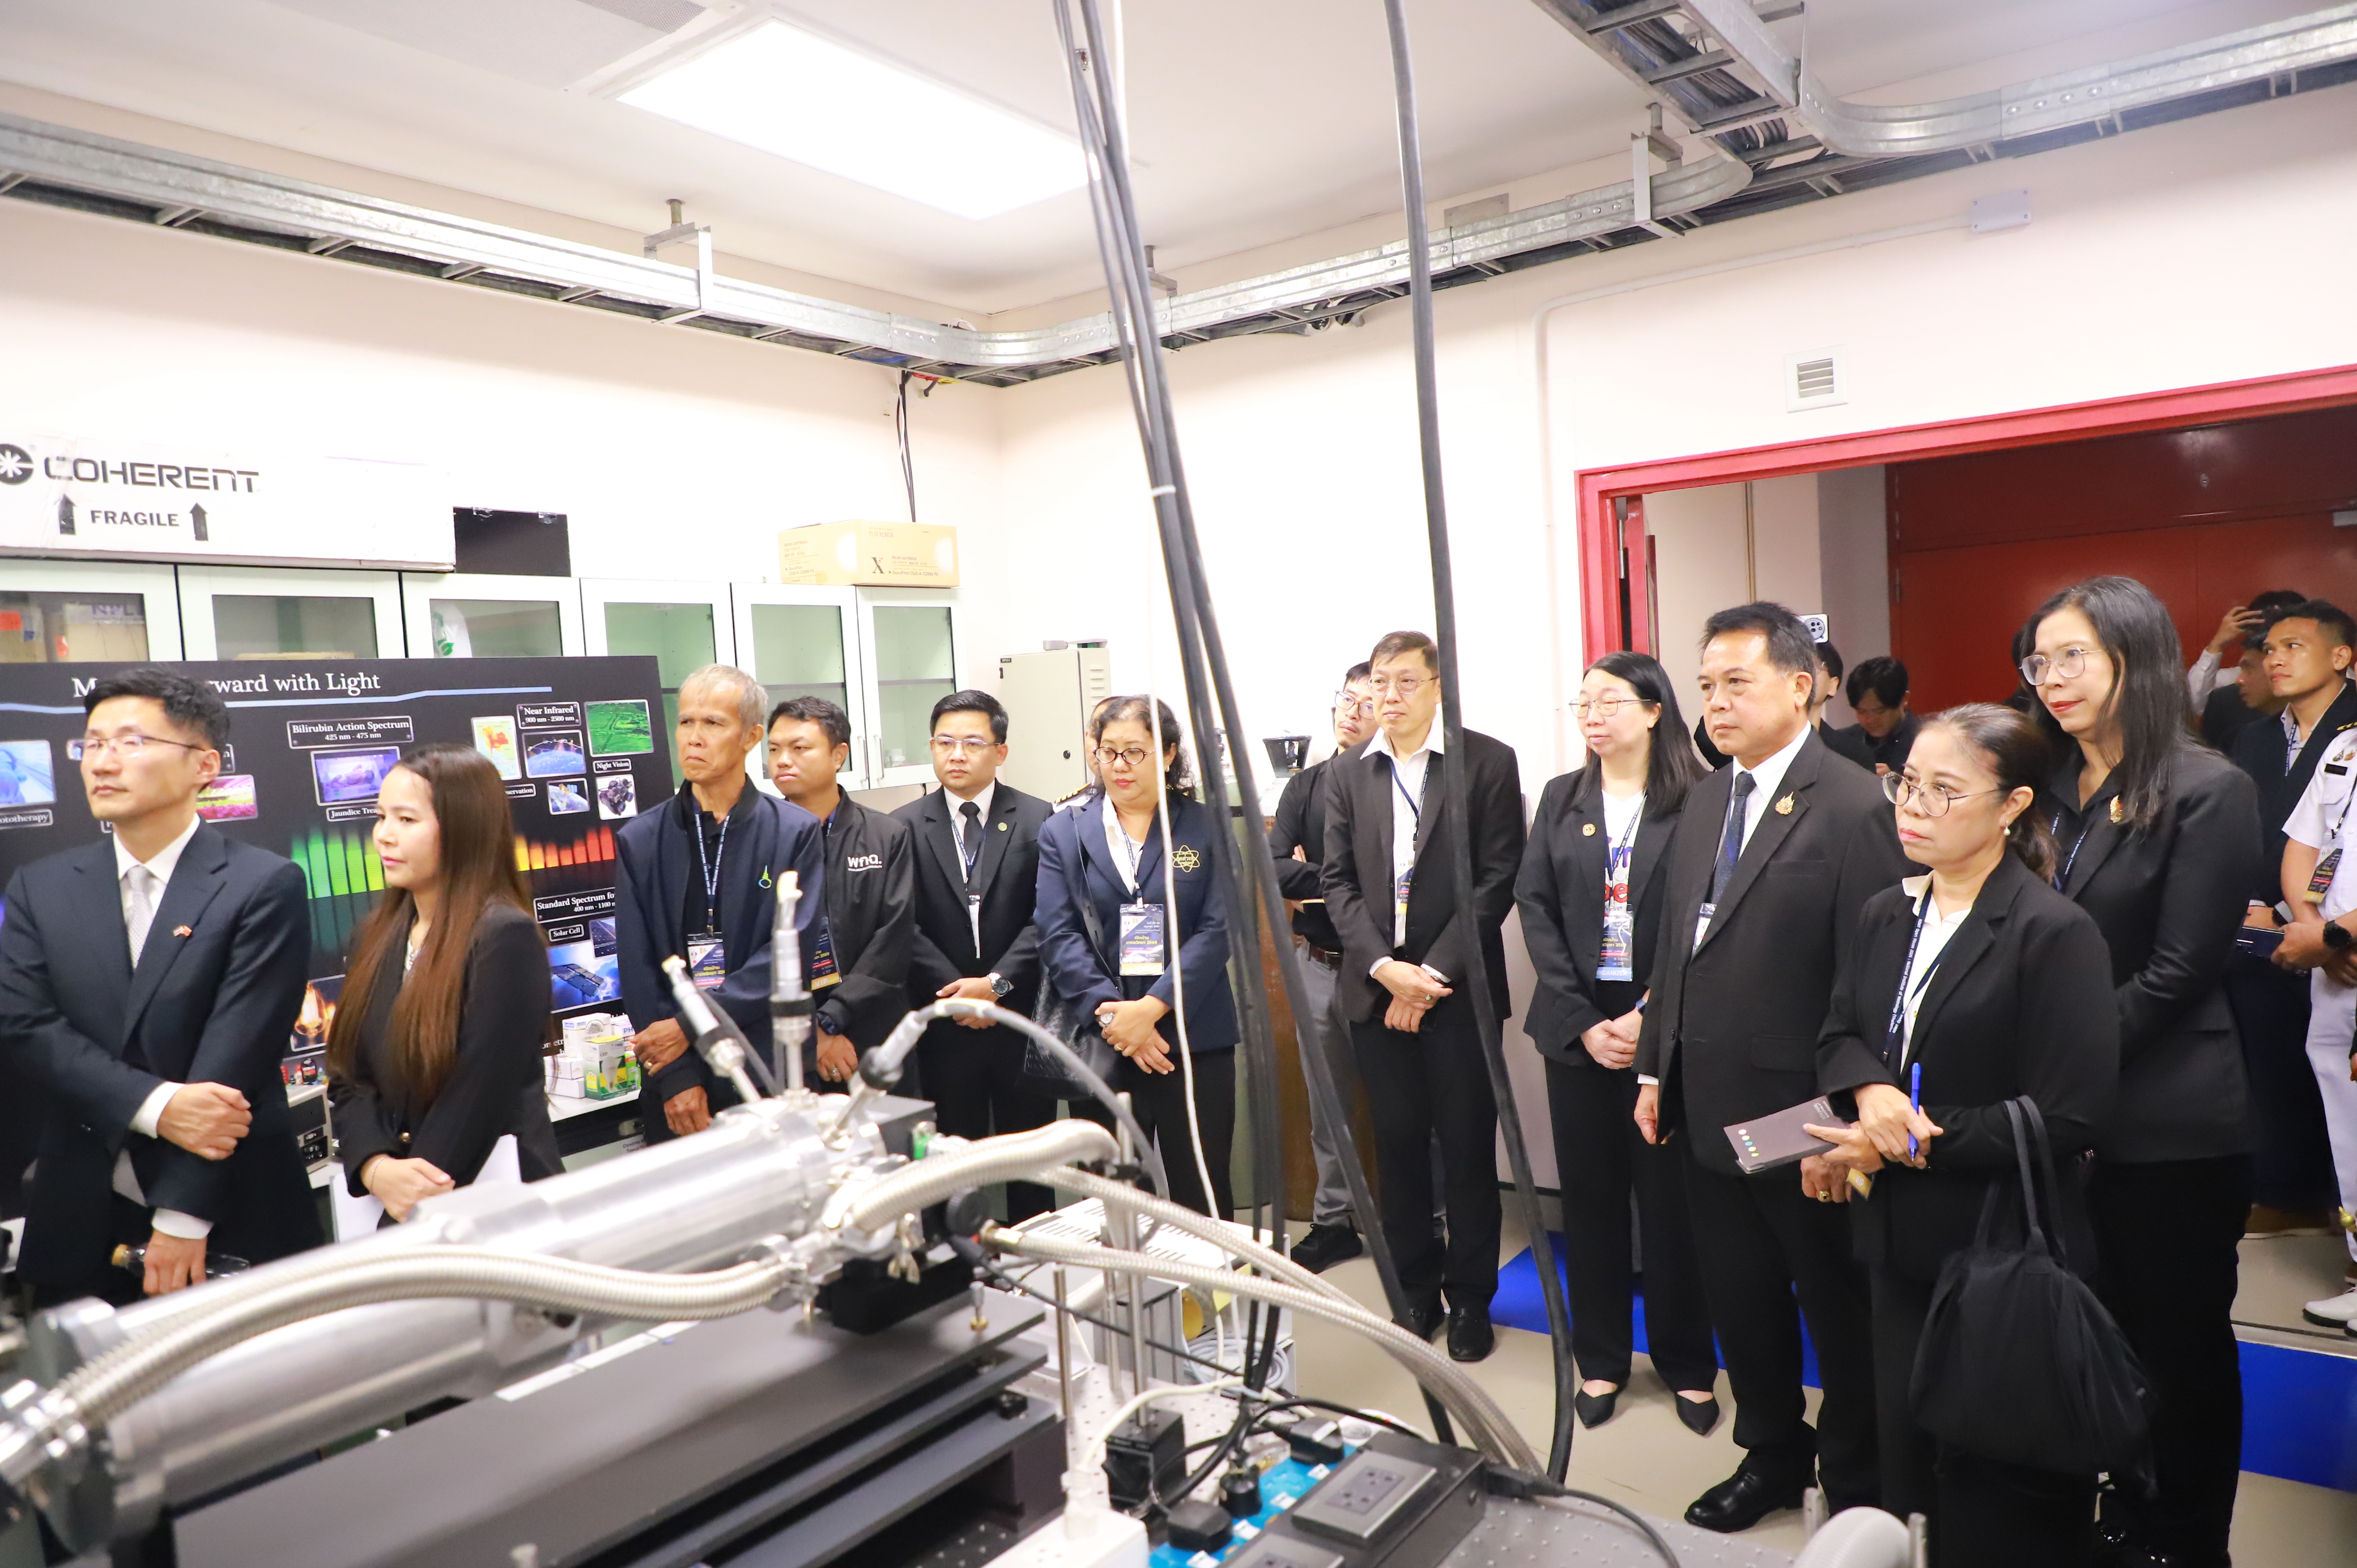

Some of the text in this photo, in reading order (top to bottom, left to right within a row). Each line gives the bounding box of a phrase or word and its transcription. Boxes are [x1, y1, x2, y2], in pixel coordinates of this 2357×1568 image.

[45, 456, 259, 493] COHERENT
[91, 510, 179, 526] FRAGILE
[208, 672, 381, 696] ward with Light
[544, 706, 574, 714] Infrared
[292, 721, 409, 734] Bilirubin Action Spectrum
[330, 808, 361, 819] Jaundice
[537, 897, 570, 910] Standard
[572, 894, 606, 906] Spectrum
[814, 978, 828, 987] VIP
